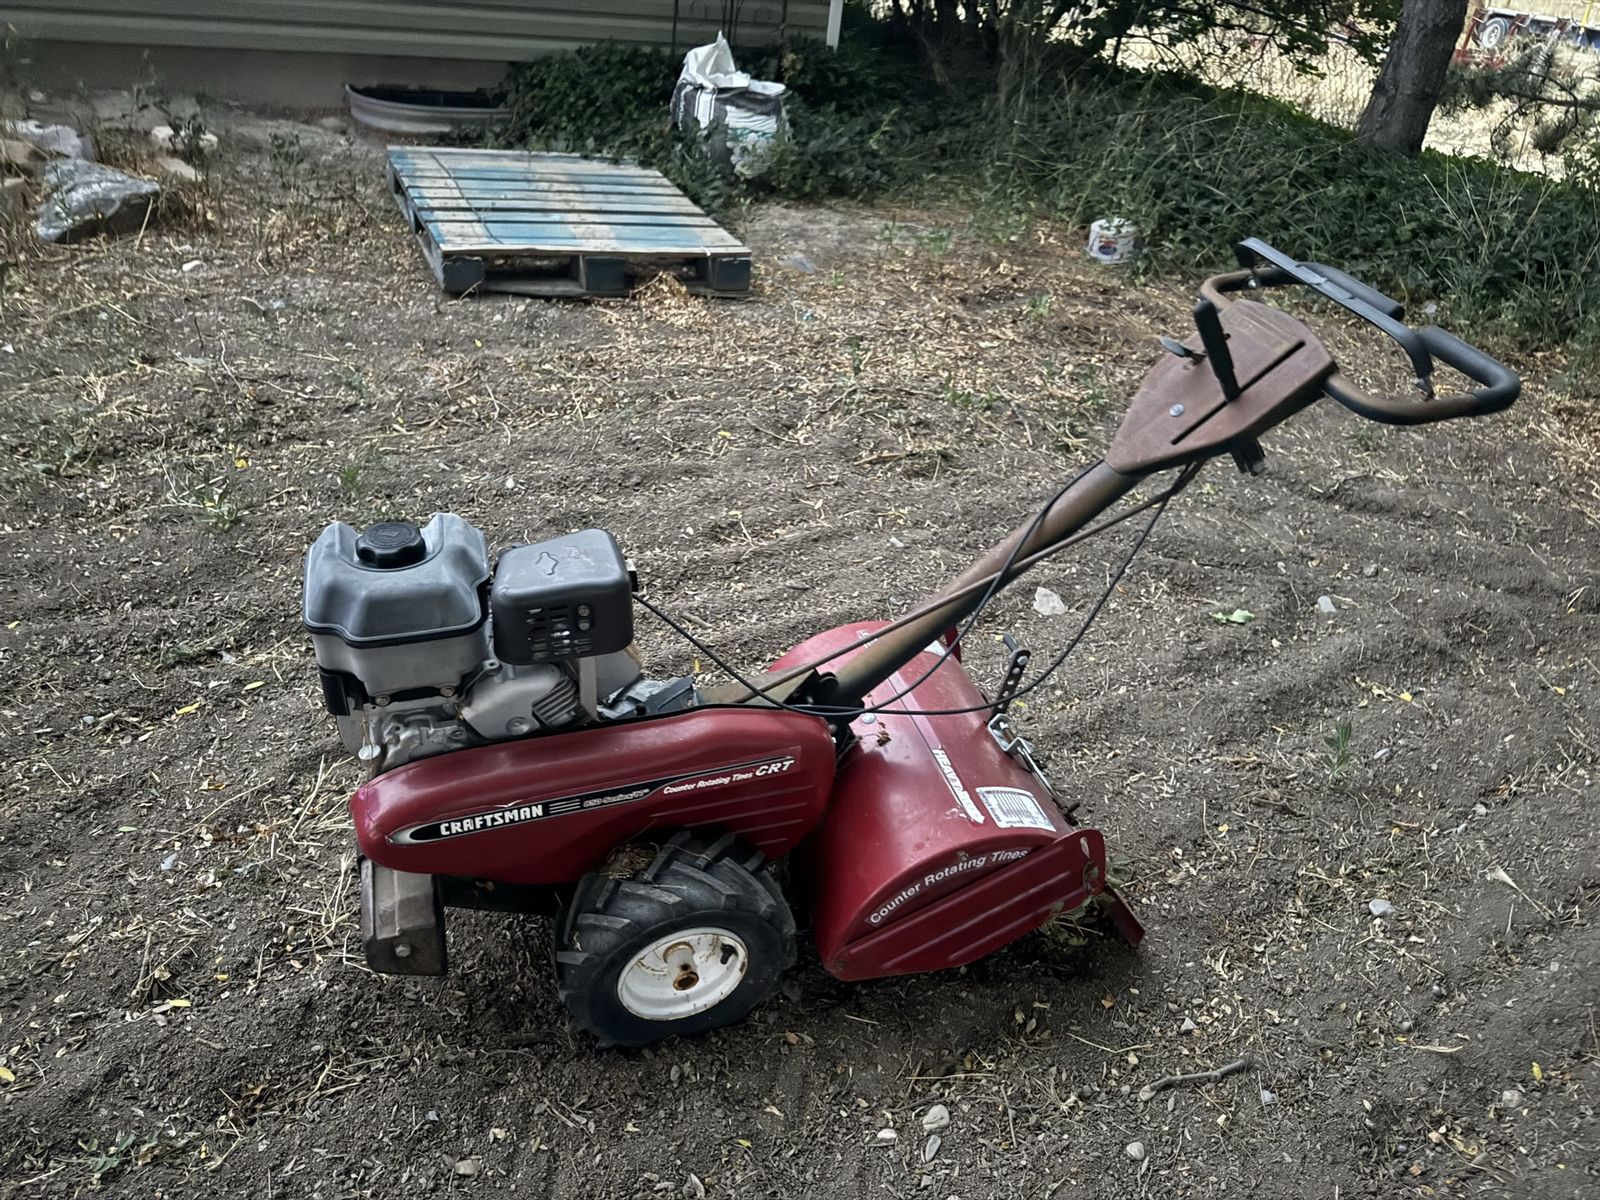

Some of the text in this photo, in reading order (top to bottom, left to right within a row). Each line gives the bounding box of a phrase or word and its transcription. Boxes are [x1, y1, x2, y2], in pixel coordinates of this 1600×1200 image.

[663, 760, 795, 794] Counter Rotating Tines CRT
[440, 804, 543, 836] CRAFTSMAN
[870, 849, 1029, 924] Counter Rotating Tines
